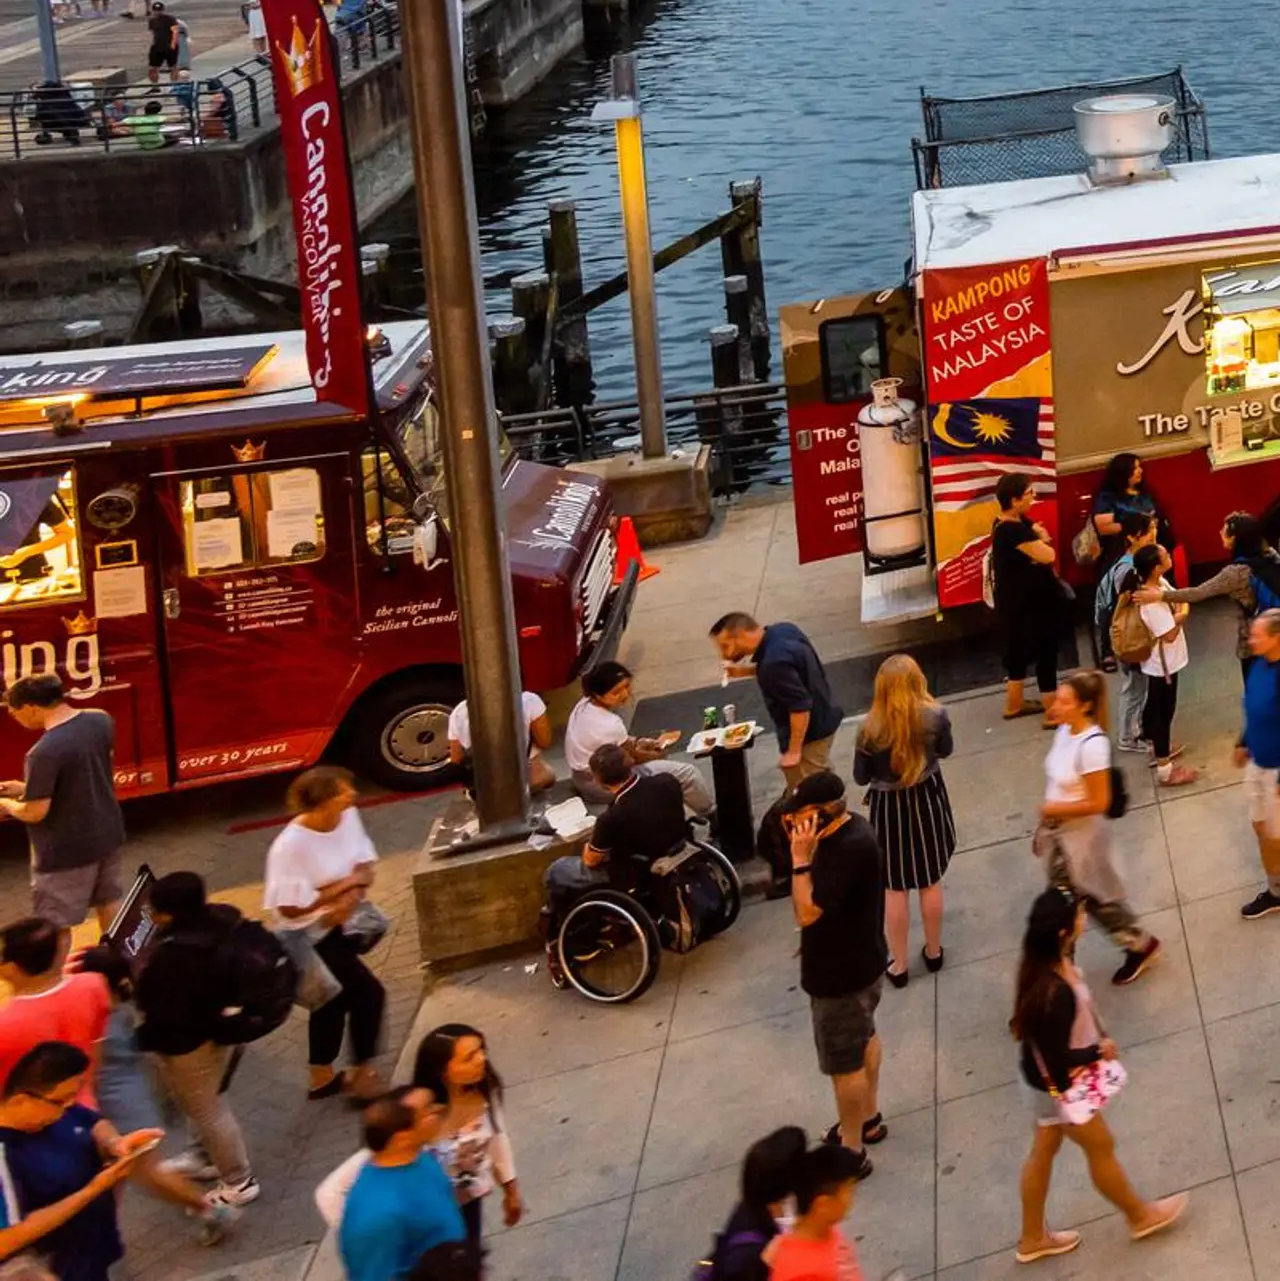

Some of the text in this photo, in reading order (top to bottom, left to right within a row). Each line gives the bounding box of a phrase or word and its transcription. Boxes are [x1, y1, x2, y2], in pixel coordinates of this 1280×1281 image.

[300, 193, 322, 322] VANCOUVER
[931, 264, 1032, 324] KAMPONG
[933, 295, 1034, 351] TASTE OF
[931, 322, 1046, 383] MALAYSIA
[813, 427, 847, 443] The
[1139, 413, 1189, 437] The
[820, 457, 861, 475] Mala
[826, 492, 850, 505] real
[833, 504, 857, 518] real
[833, 519, 858, 533] real
[375, 598, 442, 617] the original
[363, 610, 460, 635] Sicilian Cannoli
[179, 754, 215, 769] over
[221, 751, 240, 766] 30
[244, 742, 289, 763] years
